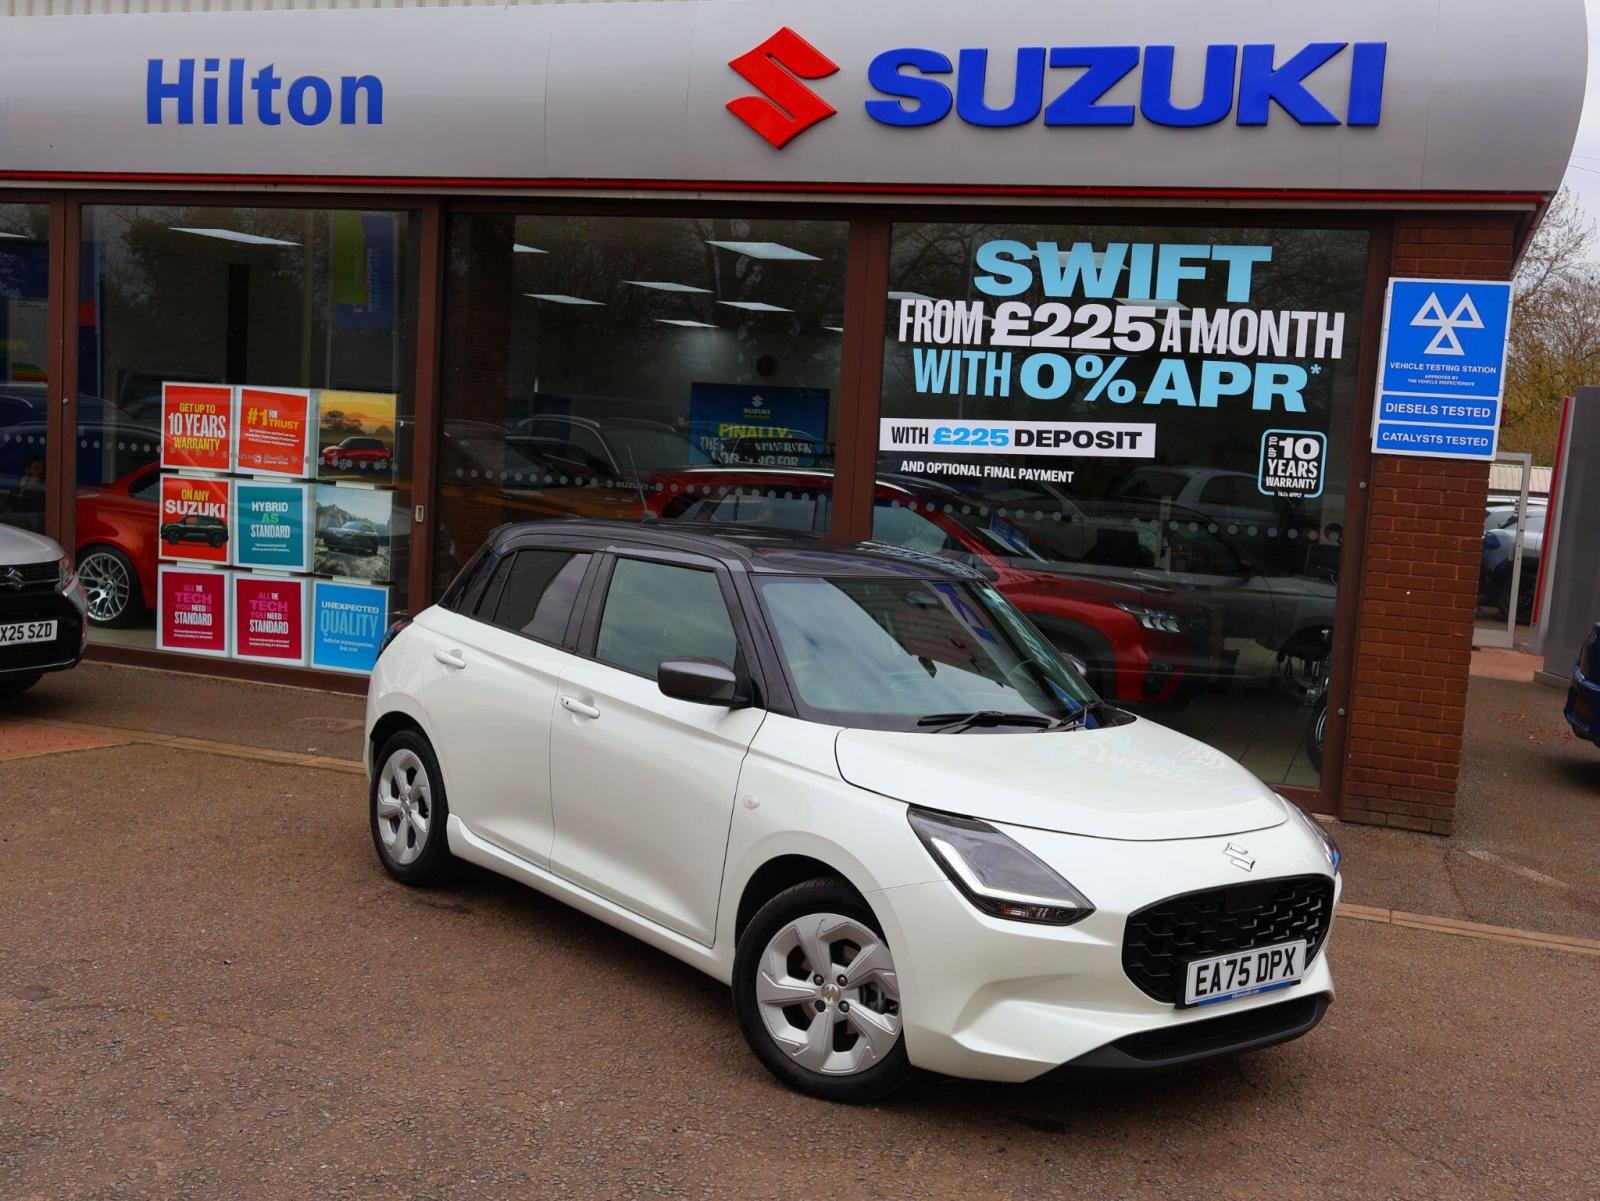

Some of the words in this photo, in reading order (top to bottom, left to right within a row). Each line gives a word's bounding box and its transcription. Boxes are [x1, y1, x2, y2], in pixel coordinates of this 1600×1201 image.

[147, 58, 382, 126] Hilton
[865, 42, 1387, 127] SUZUKI
[974, 240, 1272, 302] SWIFT
[899, 299, 992, 344] FROM
[991, 301, 1156, 352] £225
[1160, 308, 1185, 354] A
[1189, 308, 1345, 360] MONTH
[1390, 362, 1424, 371] VEHICLE
[1426, 363, 1460, 372] TESTING
[1462, 365, 1496, 374] STATION
[913, 349, 1012, 397] WITH
[1020, 352, 1138, 404] 0%
[180, 403, 193, 412] GET
[194, 404, 205, 413] UP
[206, 404, 216, 414] TO
[1386, 403, 1438, 415] DIESELS
[1441, 405, 1490, 418] TESTED
[247, 407, 269, 426] #1
[168, 412, 182, 436] 10
[185, 413, 226, 438] YEARS
[269, 419, 300, 430] TRUST
[174, 436, 221, 451] WARRANTY
[891, 426, 929, 445] WITH
[933, 426, 1010, 447] £225
[1014, 429, 1143, 450] DEPOSIT
[1269, 436, 1278, 446] TO
[1382, 432, 1443, 444] CATALYSTS
[1446, 435, 1488, 446] TESTED
[1268, 447, 1276, 457] UP
[1279, 437, 1320, 460] 10
[900, 460, 925, 473] AND
[926, 462, 982, 477] OPTIONAL
[984, 465, 1017, 479] FINAL
[1019, 468, 1074, 483] PAYMENT
[1268, 459, 1318, 478] YEARS
[1266, 476, 1317, 489] WARRANTY
[182, 489, 192, 500] ON
[194, 490, 210, 501] ANY
[165, 499, 225, 518] SUZUKI
[252, 501, 288, 512] HYBRID
[262, 512, 279, 523] AS
[251, 524, 290, 538] STANDARD
[175, 592, 212, 604] TECH
[250, 600, 288, 612] TECH
[321, 600, 380, 613] UNEXPECTED
[174, 612, 212, 626] STANDARD
[321, 609, 379, 638] QUALITY
[28, 623, 52, 639] SZD
[250, 620, 288, 634] STANDARD
[1195, 954, 1251, 996] EA75
[1256, 947, 1296, 983] DPX
